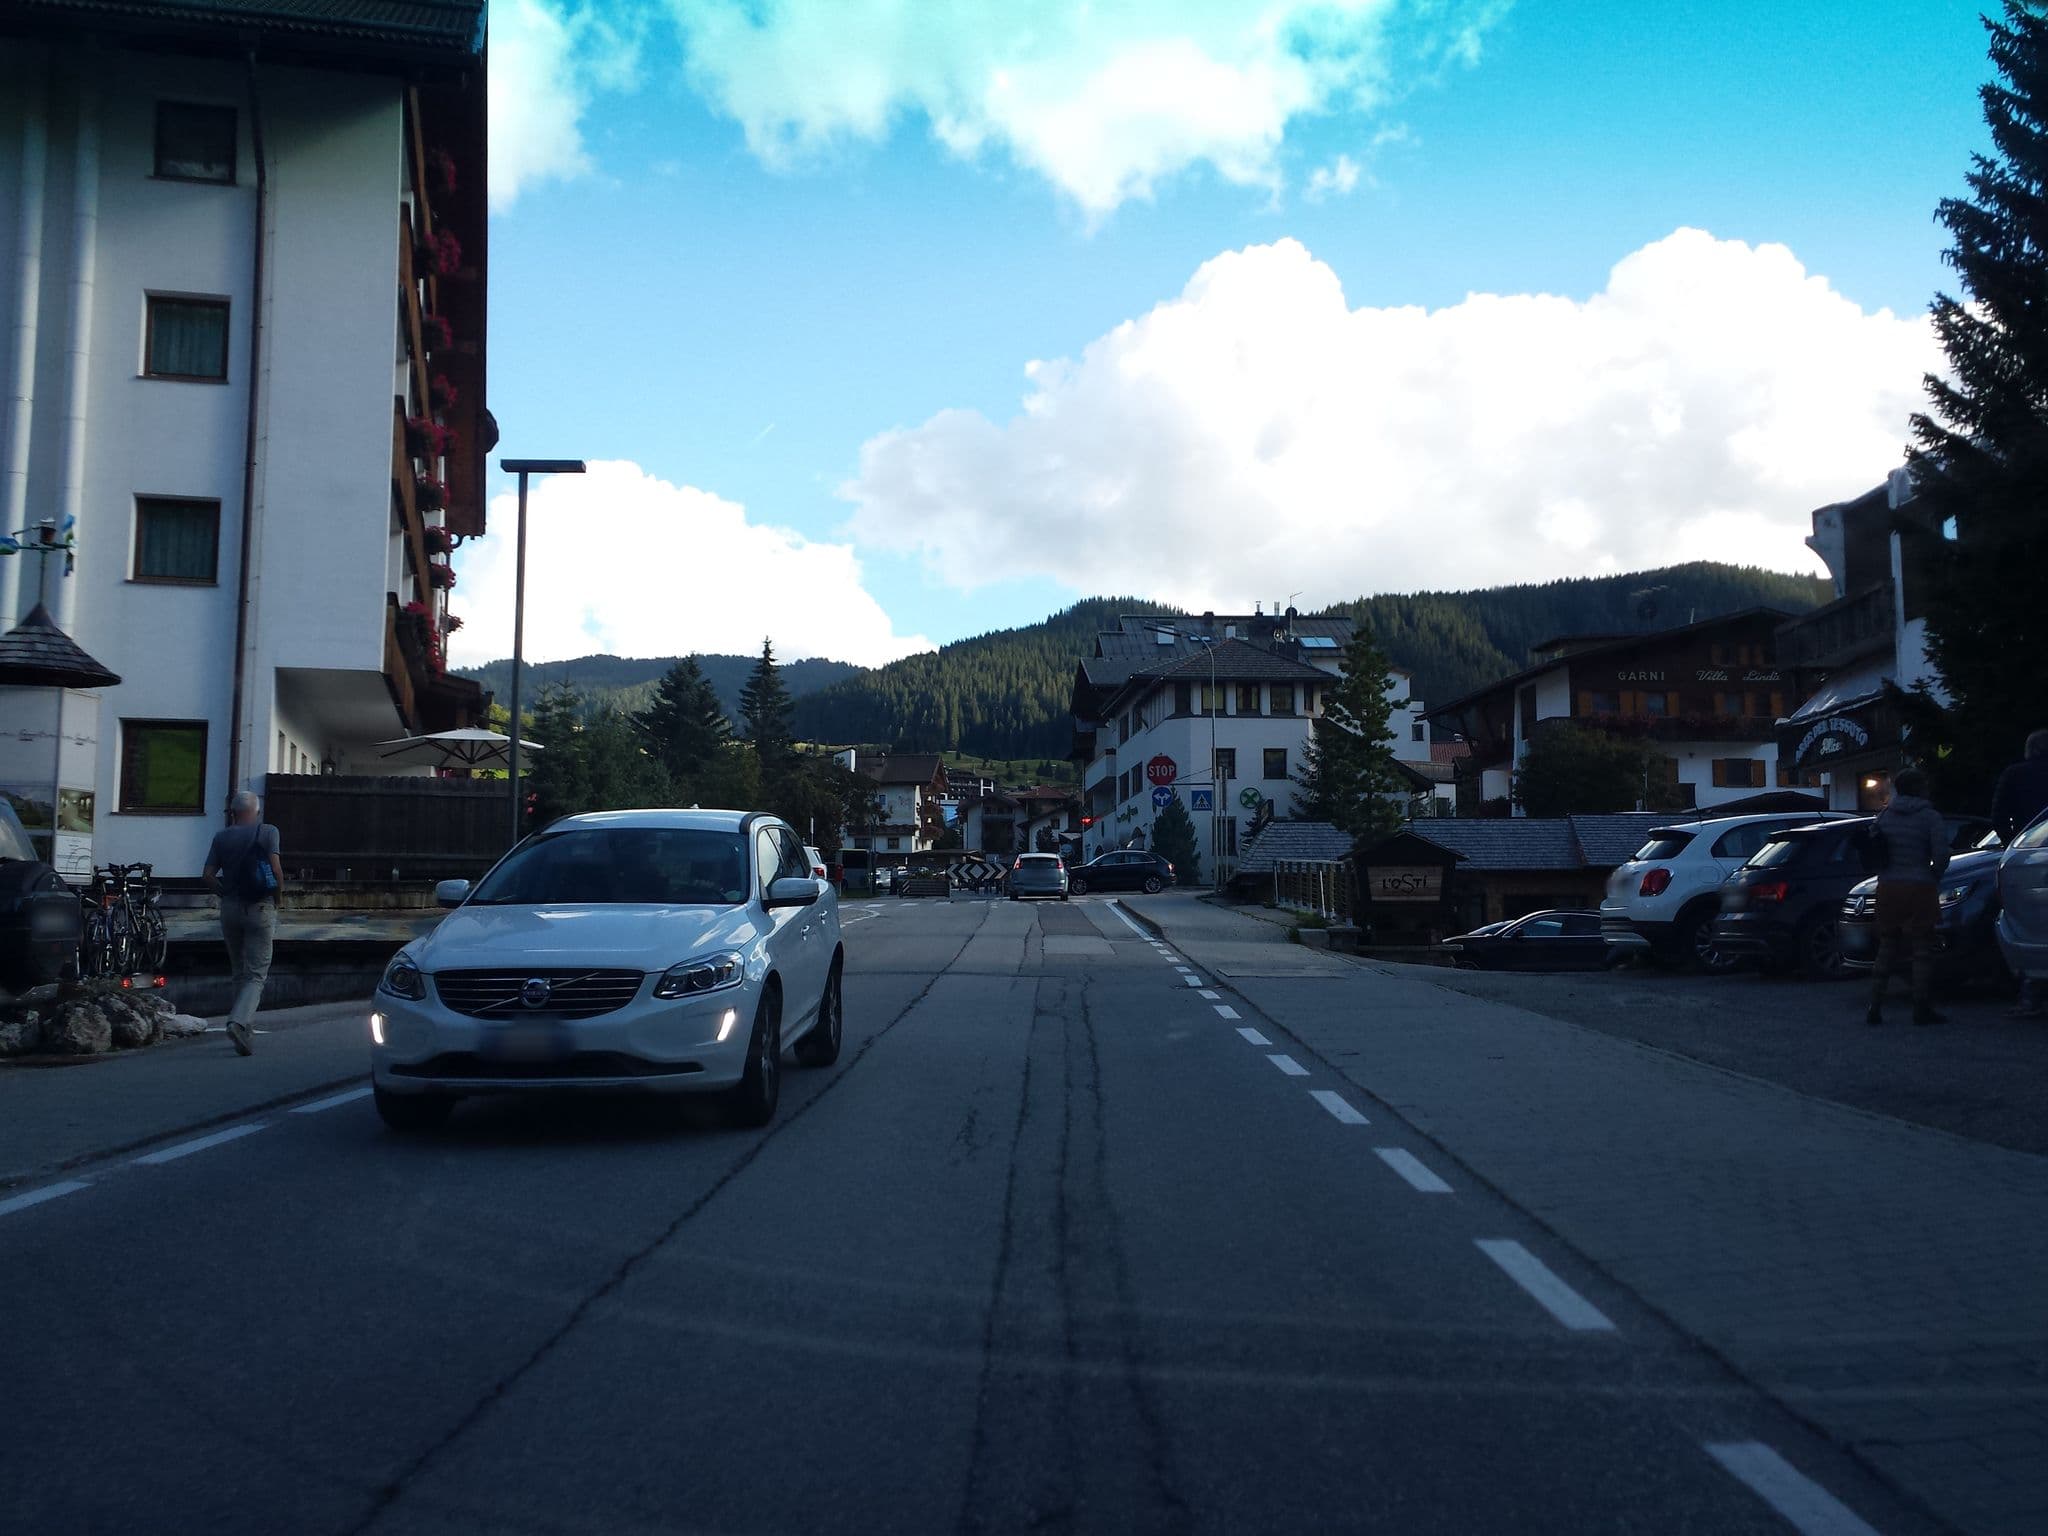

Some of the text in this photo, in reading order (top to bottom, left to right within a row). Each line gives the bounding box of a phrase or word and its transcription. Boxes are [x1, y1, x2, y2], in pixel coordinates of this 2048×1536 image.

[1617, 671, 1665, 681] GARNI
[1696, 670, 1729, 681] Villa
[1149, 765, 1175, 777] STOP
